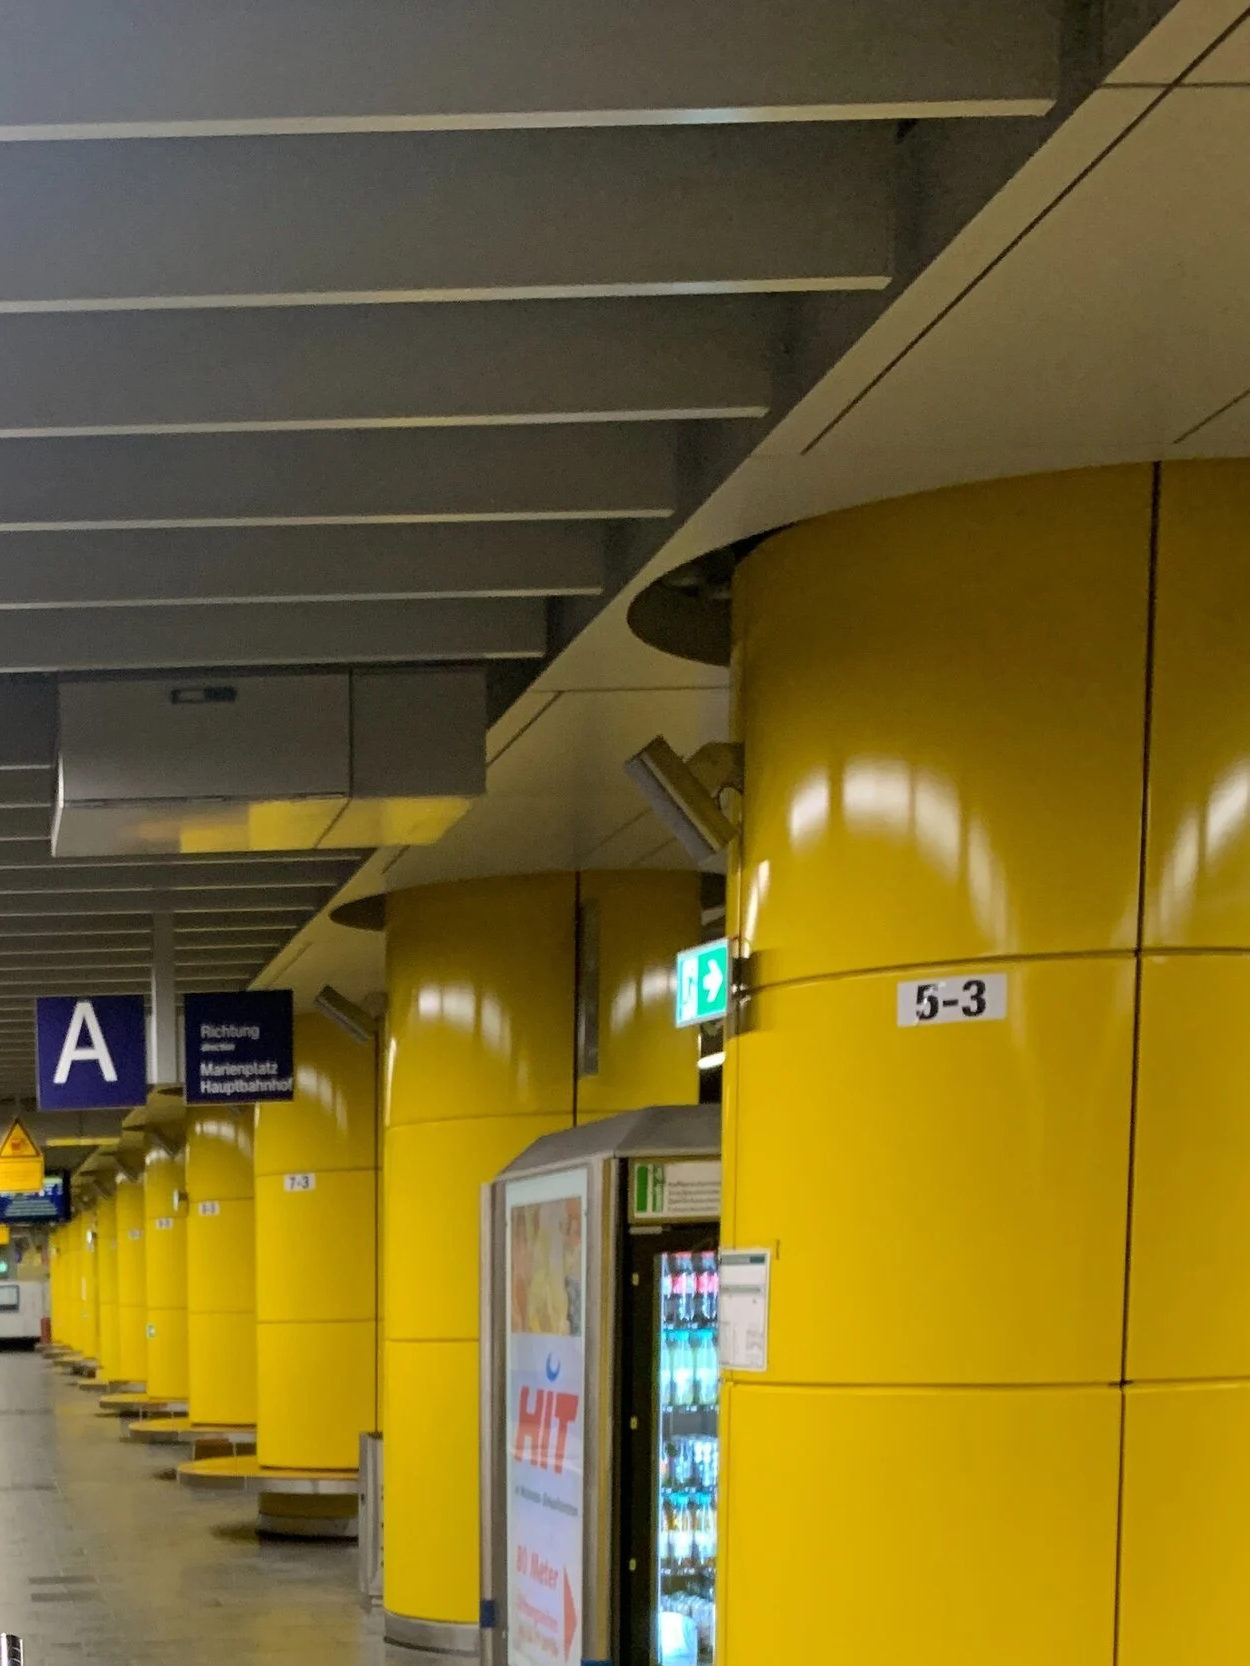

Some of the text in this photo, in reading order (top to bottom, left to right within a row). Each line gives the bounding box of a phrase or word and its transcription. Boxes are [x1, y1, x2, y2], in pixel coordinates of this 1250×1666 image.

[915, 979, 986, 1021] 5-3
[53, 1000, 118, 1085] A
[200, 1024, 260, 1040] Richtung
[199, 1061, 279, 1078] Marienplatz
[199, 1077, 293, 1097] Hauptbahnhof
[514, 1385, 579, 1475] HIT
